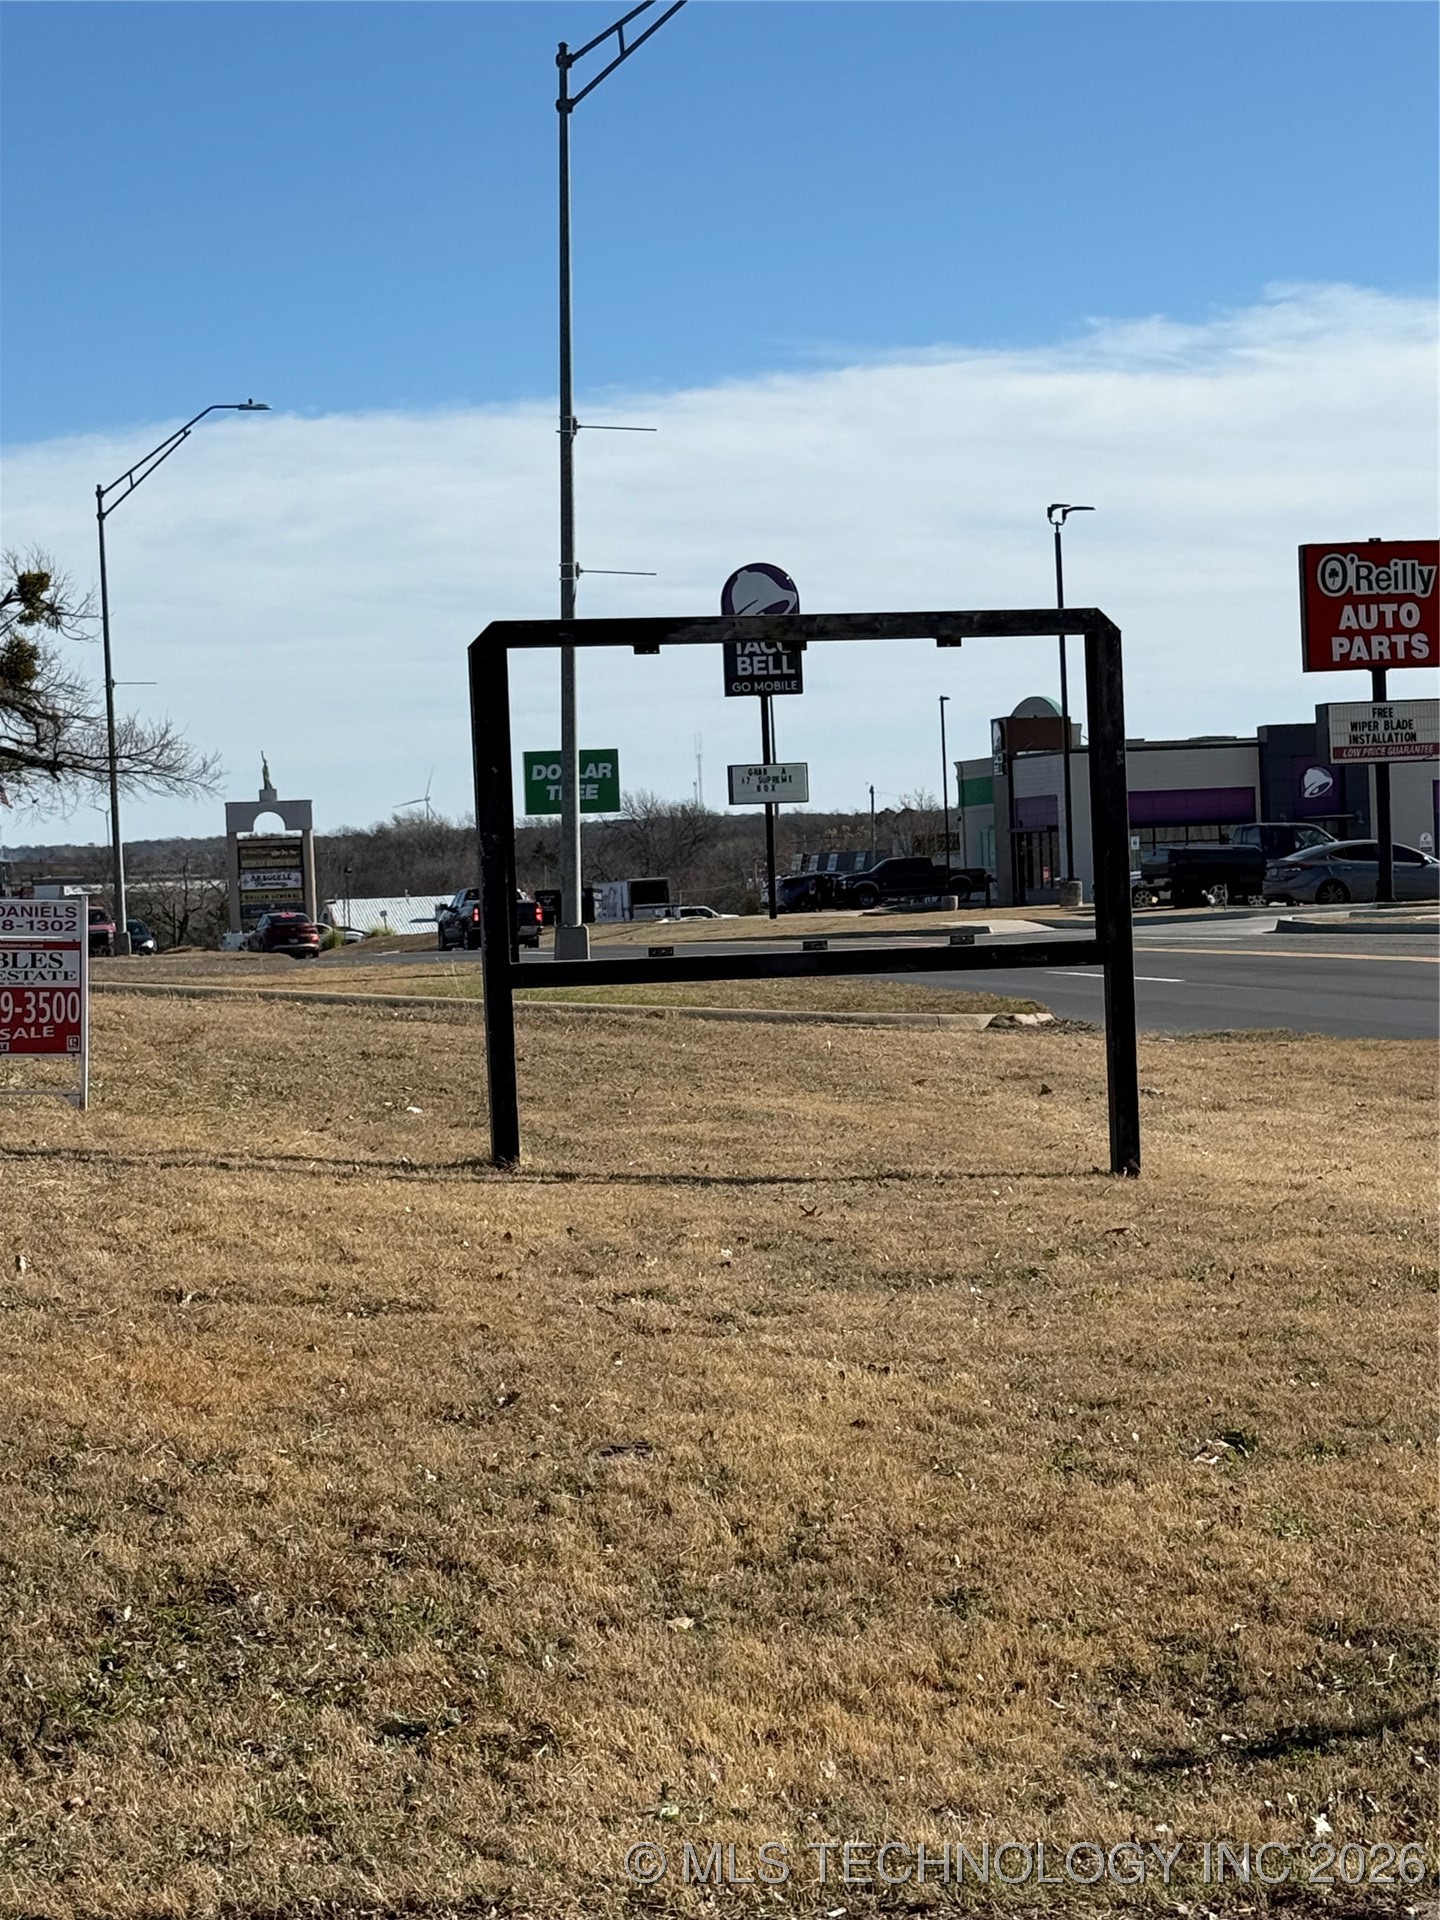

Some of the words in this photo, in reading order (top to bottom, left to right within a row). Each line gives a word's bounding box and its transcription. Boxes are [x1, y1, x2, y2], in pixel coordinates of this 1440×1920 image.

[1317, 554, 1437, 598] O'Reilly
[1339, 602, 1420, 630] AUTO
[1331, 633, 1430, 662] PARTS
[737, 655, 796, 676] BELL
[732, 682, 751, 693] GO
[754, 680, 798, 692] MOBILE
[1372, 707, 1394, 719] FREE
[1350, 721, 1379, 732] WIPER
[1384, 719, 1414, 730] BLADE
[1349, 732, 1417, 745] INSTALLATION
[1343, 748, 1361, 757] LOW
[1363, 746, 1386, 756] PRICE
[1387, 744, 1433, 755] GUARANTEE
[532, 763, 612, 780] DOAR
[0, 1025, 55, 1041] SALE
